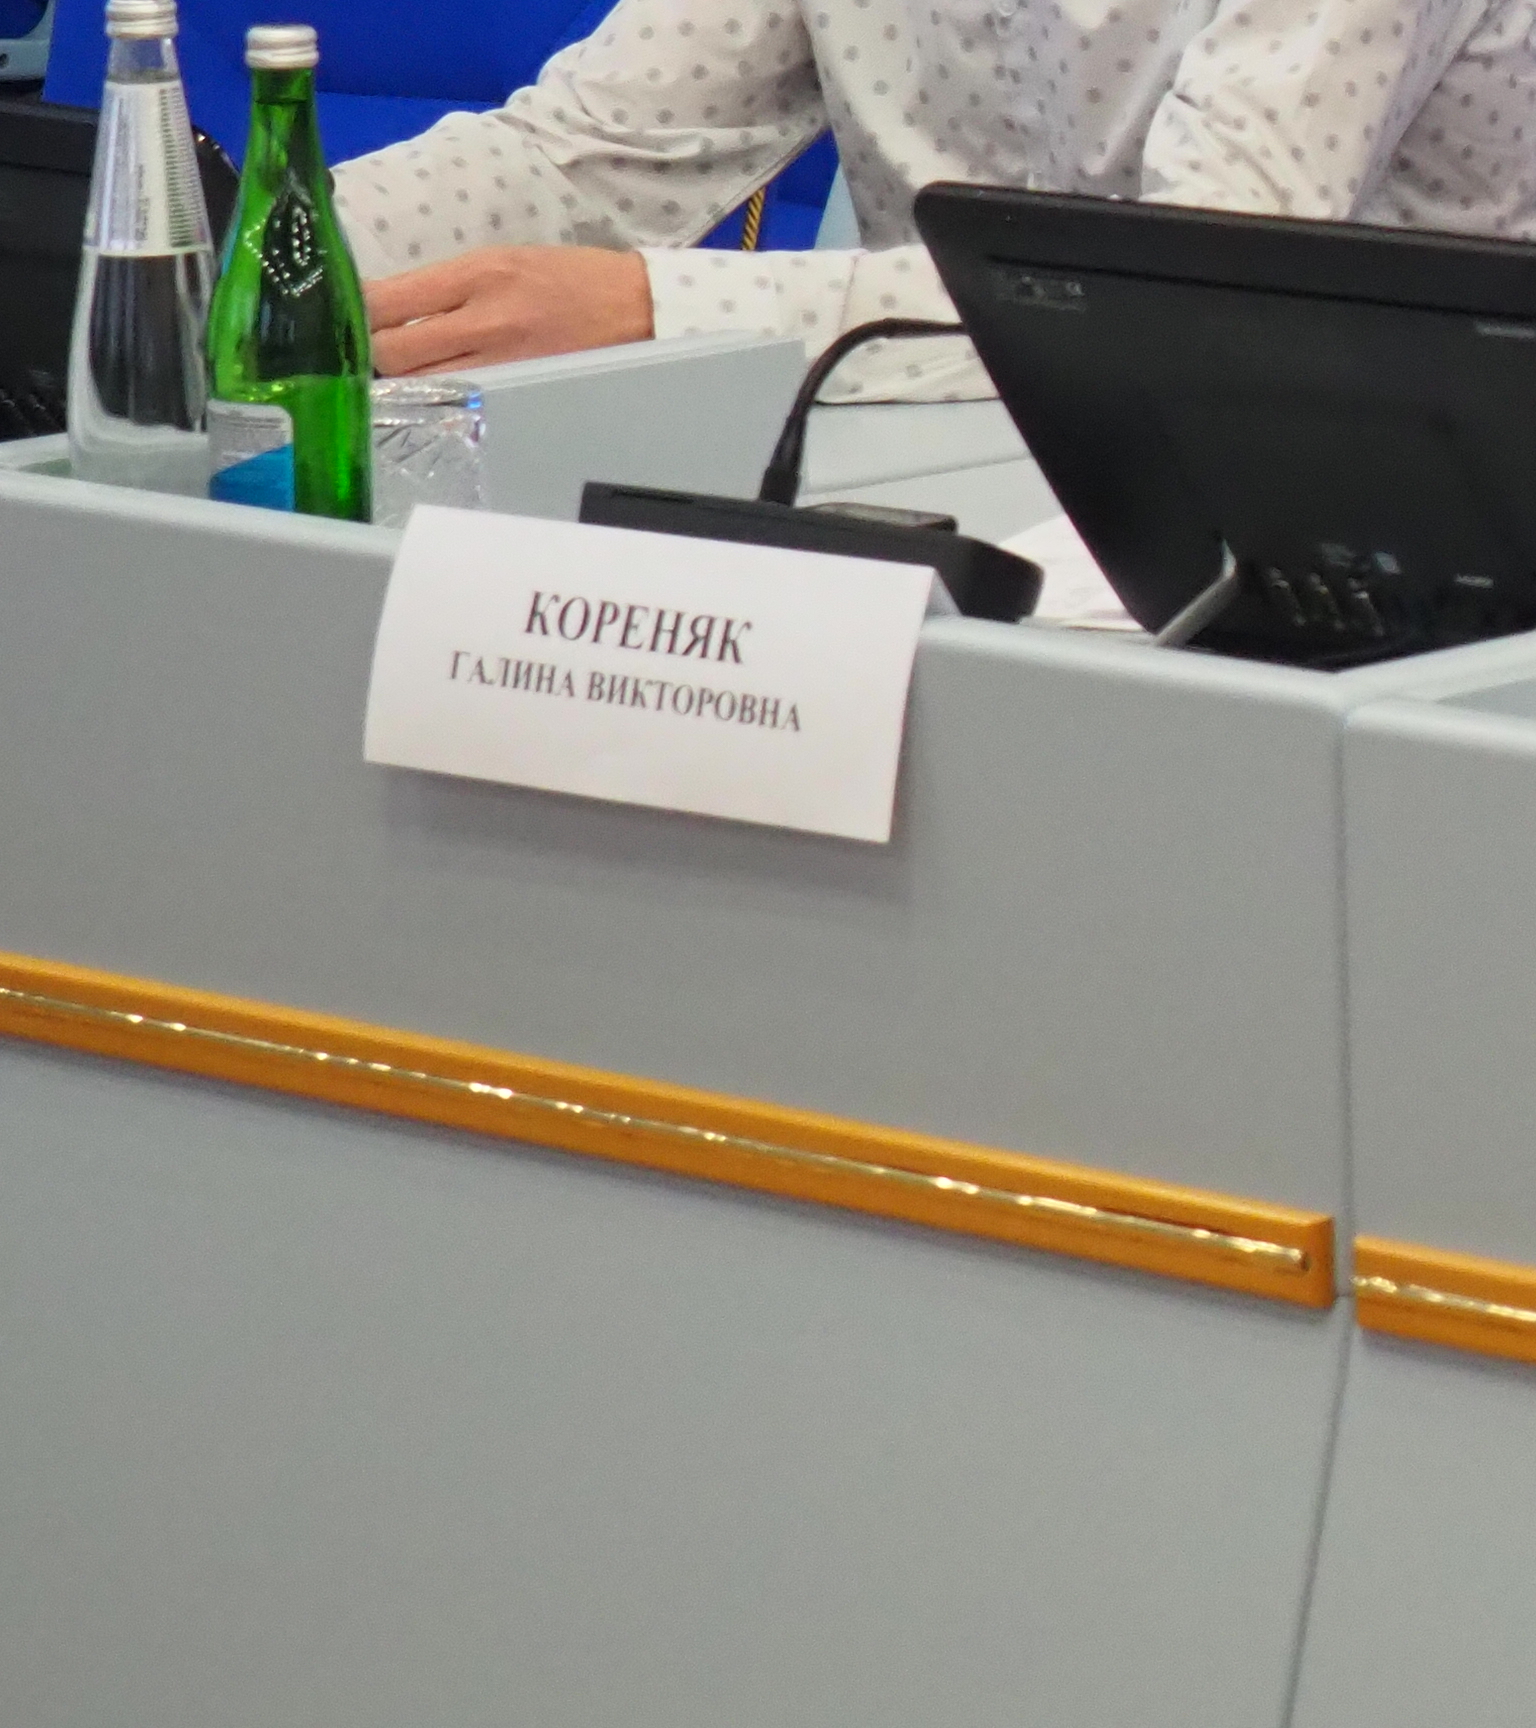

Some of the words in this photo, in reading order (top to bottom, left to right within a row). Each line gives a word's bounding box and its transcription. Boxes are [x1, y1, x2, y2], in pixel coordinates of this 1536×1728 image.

[525, 590, 752, 664] КОРЕНЯК
[450, 651, 576, 699] ГАЛИНА
[587, 672, 801, 732] ВИКТОРОВНА
